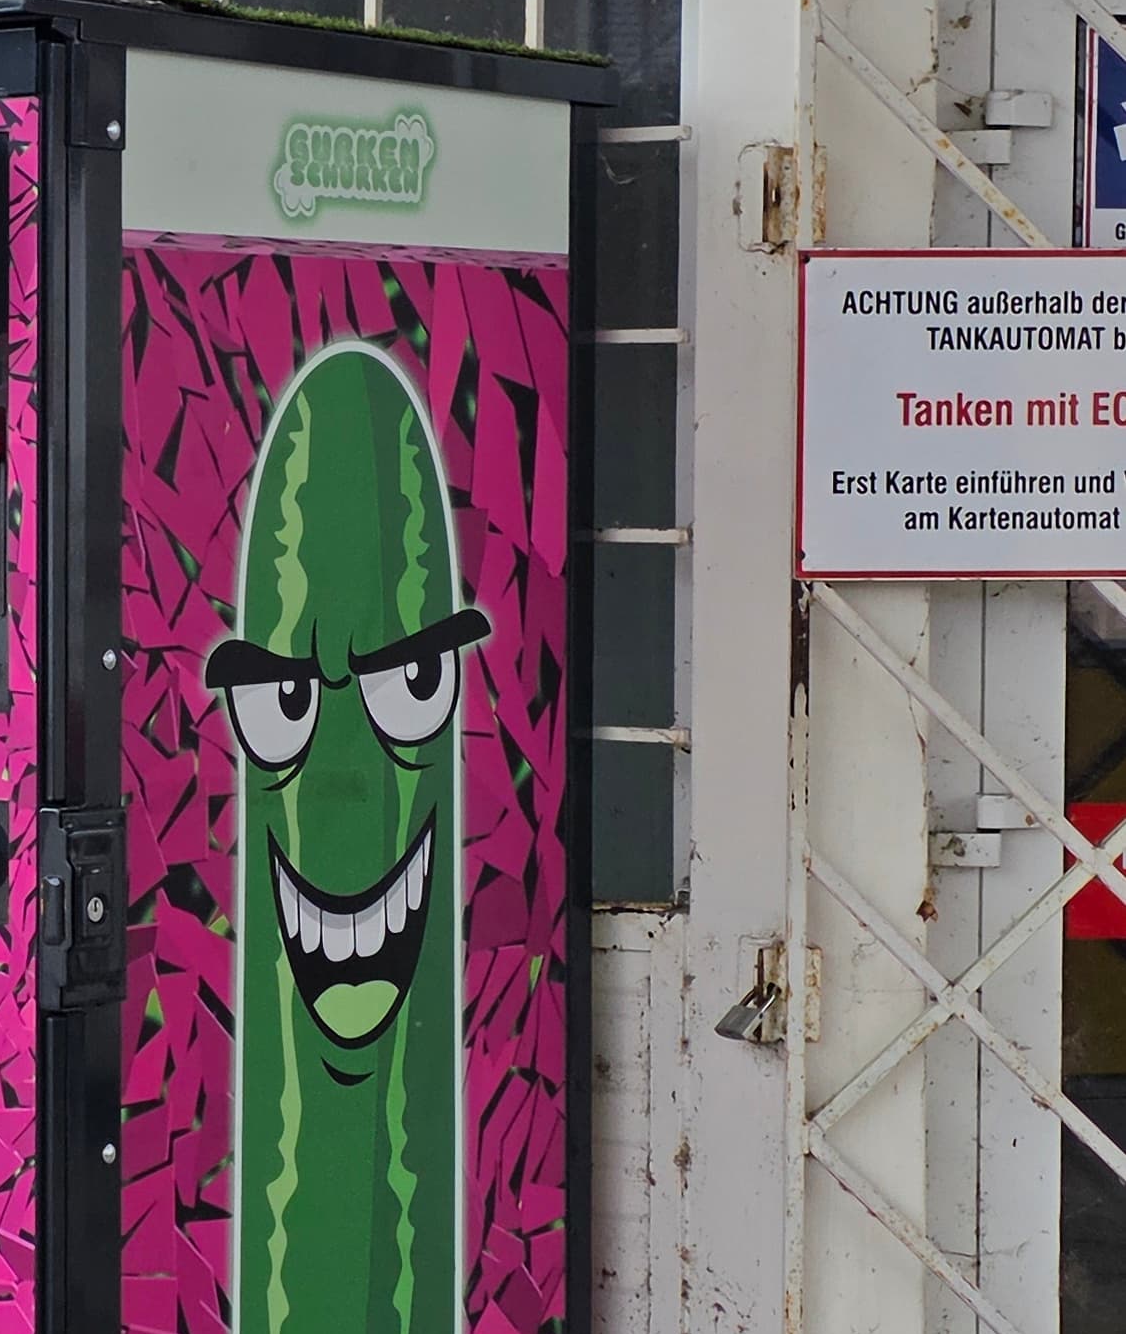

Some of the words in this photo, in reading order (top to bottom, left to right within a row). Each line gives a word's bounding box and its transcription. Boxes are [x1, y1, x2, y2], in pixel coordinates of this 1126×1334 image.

[842, 290, 958, 315] ACHTUNG
[967, 290, 1083, 315] außerhalb
[926, 326, 1106, 351] TANKAUTOMAT
[896, 392, 1013, 427] Tanken
[1027, 392, 1079, 427] mit
[832, 470, 877, 495] Erst
[885, 470, 948, 495] Karte
[956, 470, 1065, 495] einführen
[1074, 470, 1115, 495] und
[904, 511, 939, 531] am
[948, 506, 1120, 531] Kartenautomat
